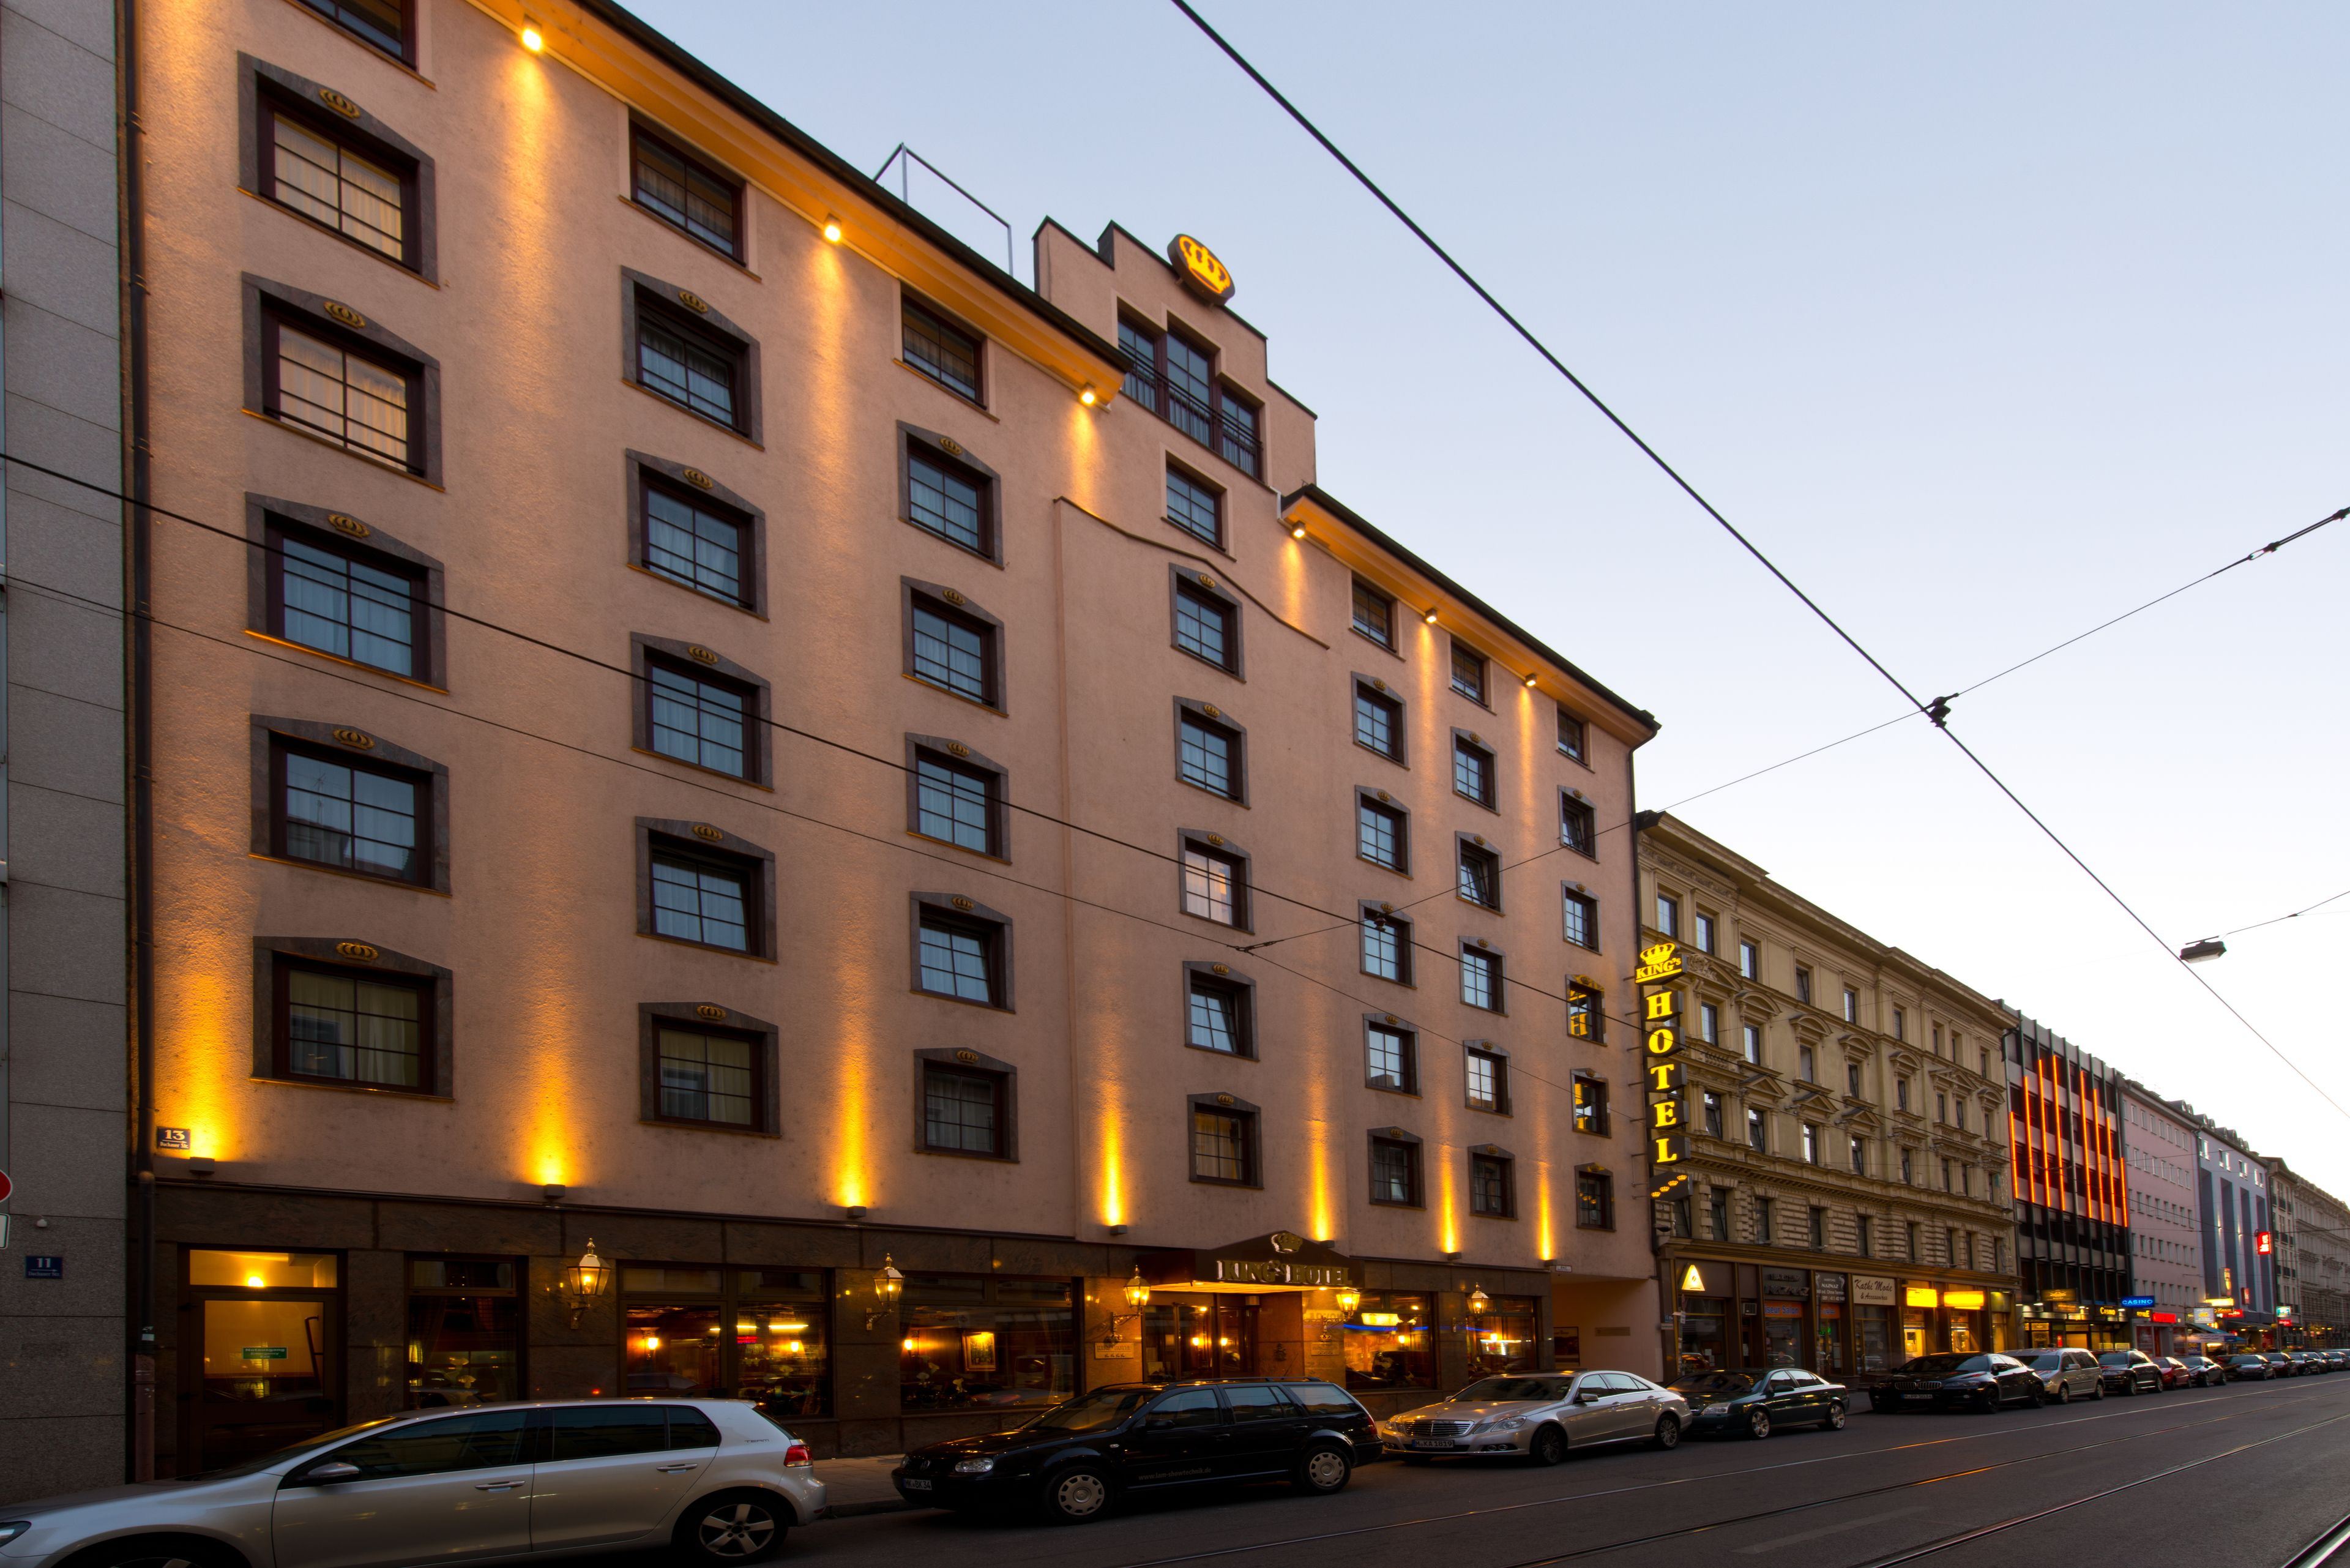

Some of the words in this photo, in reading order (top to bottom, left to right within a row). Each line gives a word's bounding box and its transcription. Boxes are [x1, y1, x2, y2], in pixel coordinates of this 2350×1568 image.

[1646, 991, 1677, 1163] HOTEL
[165, 1130, 185, 1140] 13
[36, 1258, 51, 1268] 11
[1286, 1263, 1353, 1286] HOTEL
[1854, 1279, 1873, 1290] Kathi
[1874, 1280, 1893, 1292] Mode
[1781, 1304, 1799, 1315] Salon
